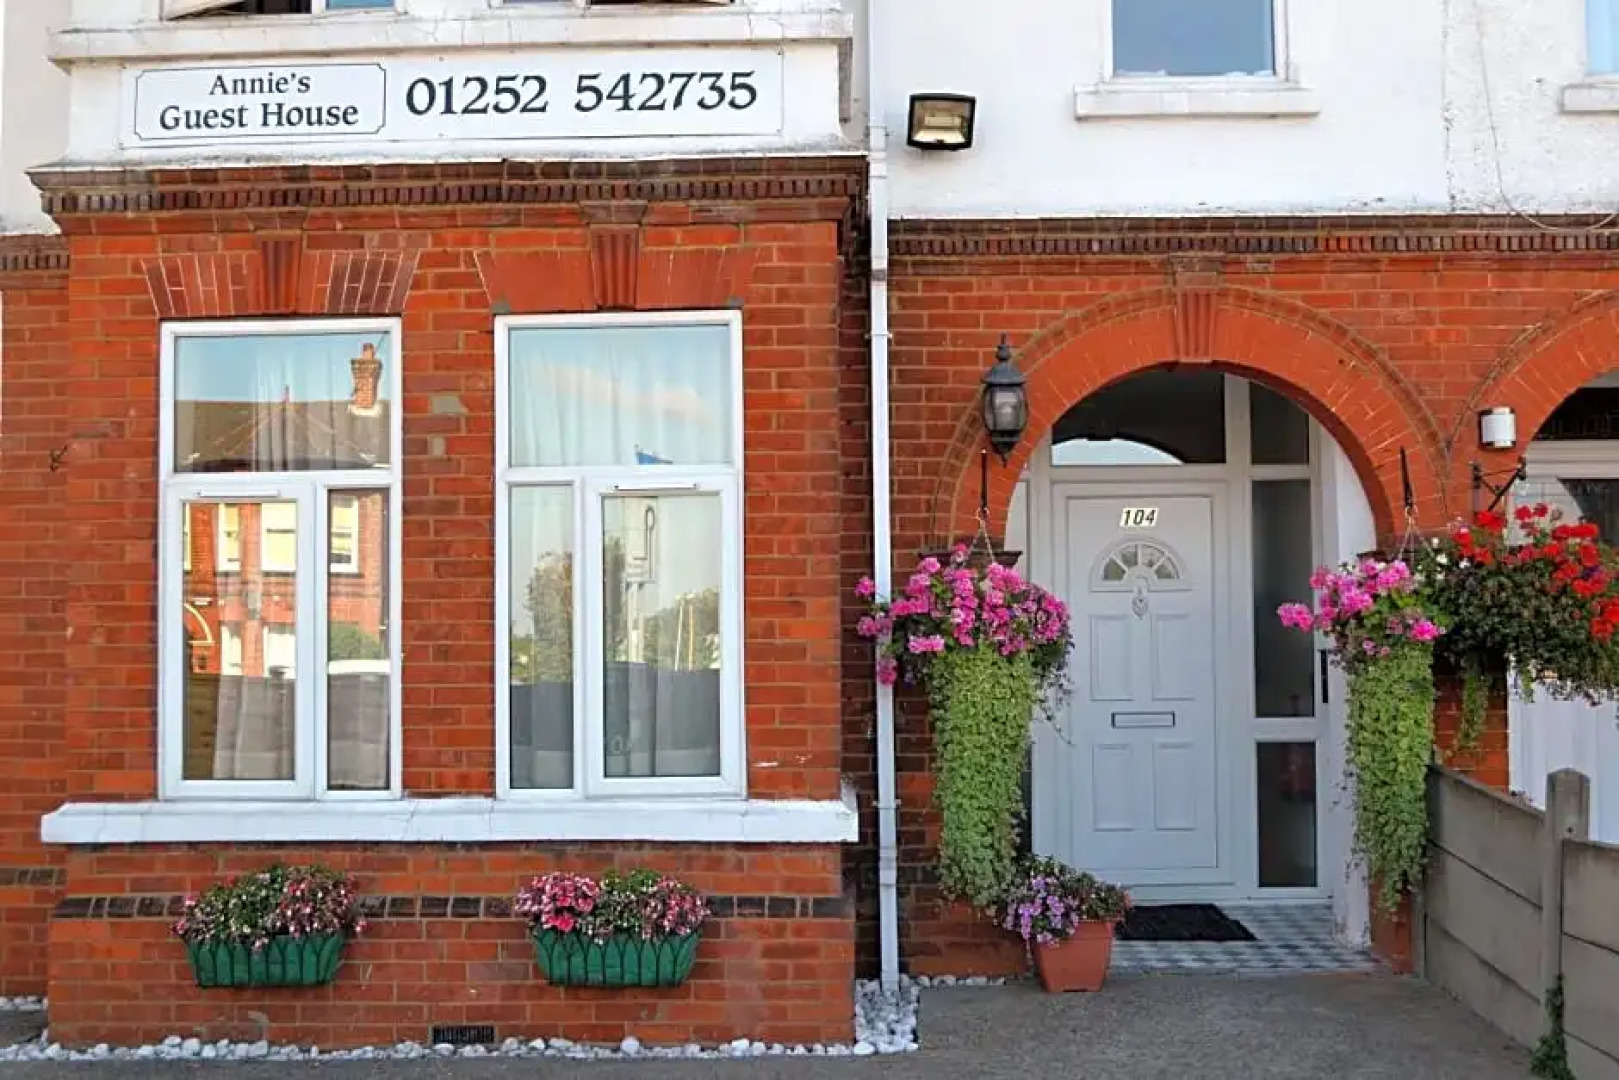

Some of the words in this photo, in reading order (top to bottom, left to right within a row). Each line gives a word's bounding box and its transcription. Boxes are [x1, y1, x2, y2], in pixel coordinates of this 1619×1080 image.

[209, 72, 311, 96] Annie's
[405, 73, 549, 116] 01252
[573, 70, 757, 113] 542735
[159, 104, 248, 130] Guest
[261, 102, 359, 127] House
[1123, 509, 1157, 526] 104
